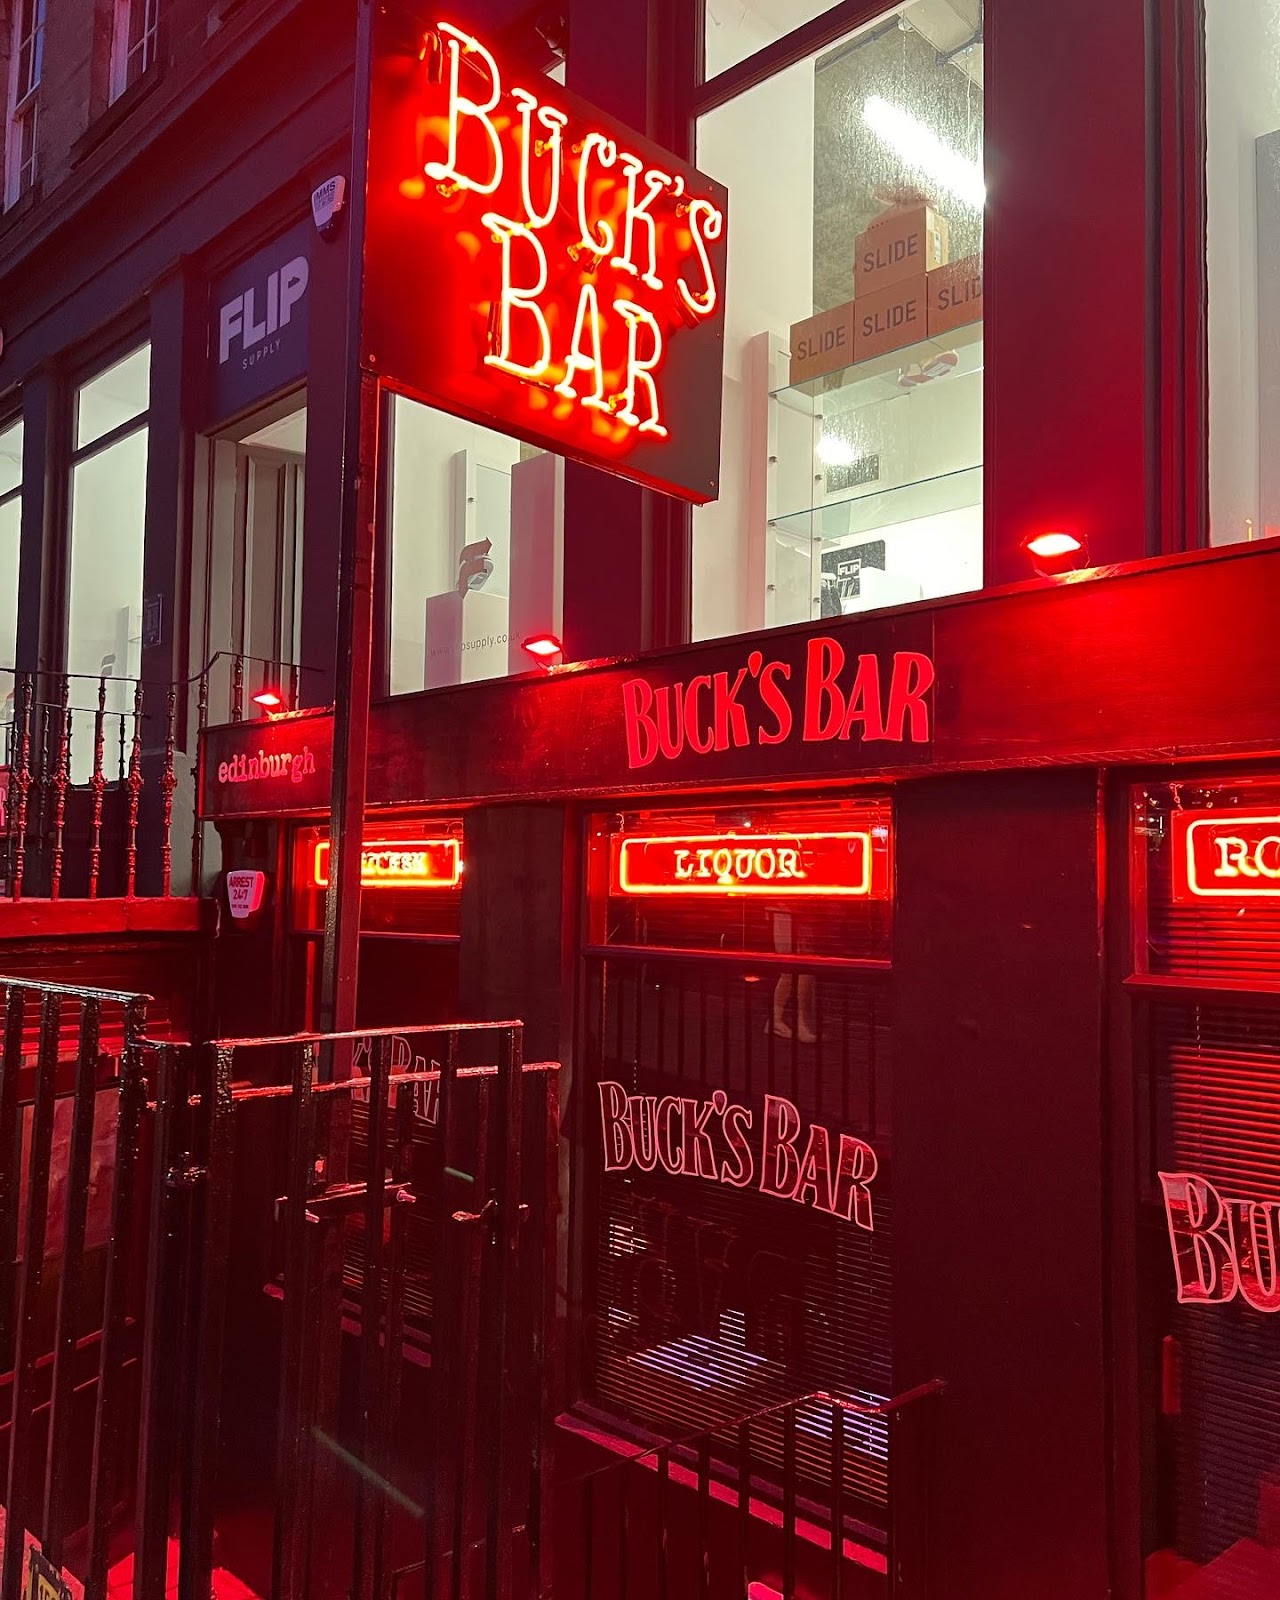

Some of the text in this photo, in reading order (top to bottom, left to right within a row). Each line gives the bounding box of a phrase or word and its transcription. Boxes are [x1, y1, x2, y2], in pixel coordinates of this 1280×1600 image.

[424, 21, 722, 314] BUCK'S
[863, 233, 918, 273] SLIDE
[219, 256, 309, 364] FLIP
[938, 276, 982, 311] SLID
[482, 212, 668, 437] BAR
[862, 299, 918, 338] SLIDE
[242, 338, 282, 370] SUPPLY
[797, 325, 846, 361] SLIDE
[839, 564, 860, 576] FLIP
[622, 637, 935, 769] BUCK'S BAR
[218, 746, 316, 784] edinburgh
[673, 847, 807, 886] LIQUOR
[1213, 835, 1280, 878] RO
[229, 876, 254, 888] ARREST
[597, 1080, 879, 1232] BUCK'S BAR
[1157, 1171, 1280, 1313] BU
